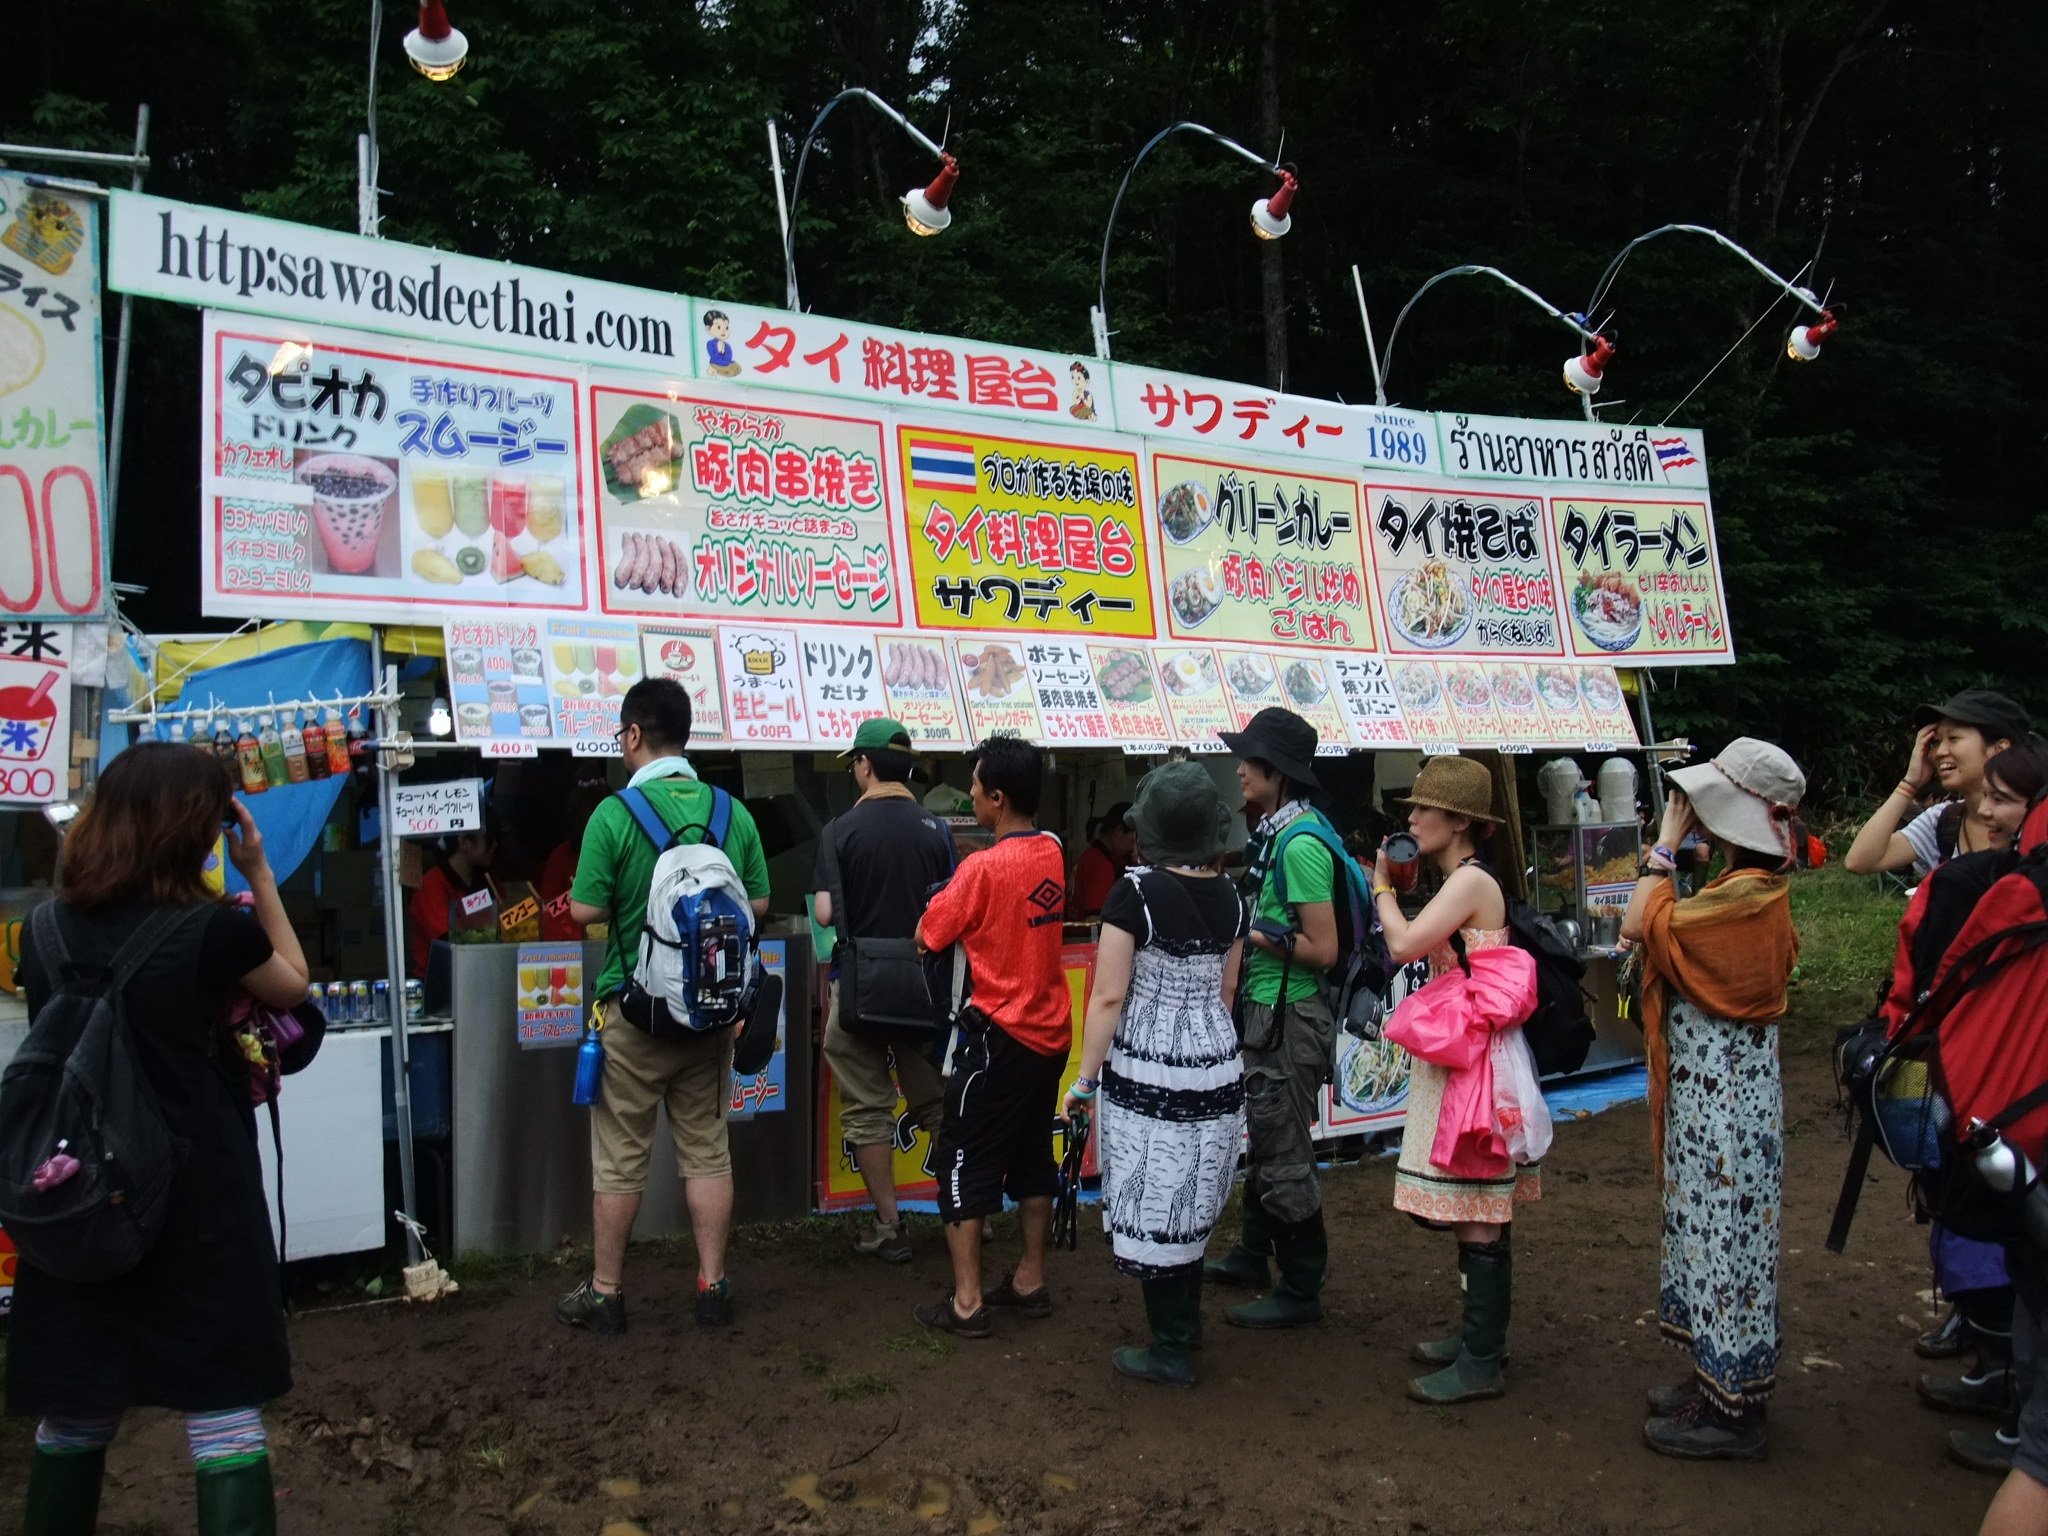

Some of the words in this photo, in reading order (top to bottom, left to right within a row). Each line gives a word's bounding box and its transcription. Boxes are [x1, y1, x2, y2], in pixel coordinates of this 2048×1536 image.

[745, 320, 1059, 412] タイ料理屋台
[227, 350, 389, 424] タピオカ
[411, 375, 555, 417] 手作りフルーツ
[251, 411, 358, 449] ドリンク
[694, 406, 786, 442] やわらか
[1140, 383, 1343, 449] サワディー
[1374, 411, 1416, 429] since
[395, 411, 569, 463] スムージー
[1367, 426, 1427, 466] 1989
[222, 439, 294, 472] カフェオレ
[690, 436, 882, 510] 豚肉串焼き
[981, 451, 1135, 507] プロが作る本場の味
[708, 506, 857, 540] 旨さがギュッと詰まった
[1214, 470, 1352, 550] グリーンカレー
[1377, 494, 1541, 562] タイ焼そば
[923, 500, 1136, 577] タイ料理屋台
[1561, 505, 1709, 571] タイラーメン
[693, 536, 891, 611] オリジナルソーセージ
[1219, 550, 1362, 609] 豚肉バジル炒め
[1470, 567, 1554, 614] タイの屋台の味
[1639, 571, 1711, 595] ピリ辛おいしい
[933, 575, 1135, 625] サワディー
[451, 622, 538, 649] タピオカドリンク
[1269, 606, 1354, 645] ごはん
[804, 642, 873, 679] ドリンク
[1027, 645, 1083, 665] ポテト
[1336, 660, 1383, 676] ラーメン
[820, 683, 868, 701] だけ
[1032, 668, 1091, 685] ソーセージ
[733, 691, 802, 721] 生ビール
[1039, 688, 1098, 709] 豚肉串焼き
[747, 724, 792, 738] 600円
[893, 711, 954, 726] ソーセージ
[491, 743, 533, 754] 400円
[1316, 745, 1343, 754] 00円
[445, 788, 470, 799] レモン
[408, 818, 439, 831] 500
[450, 818, 464, 828] 円
[502, 902, 536, 926] マンゴー
